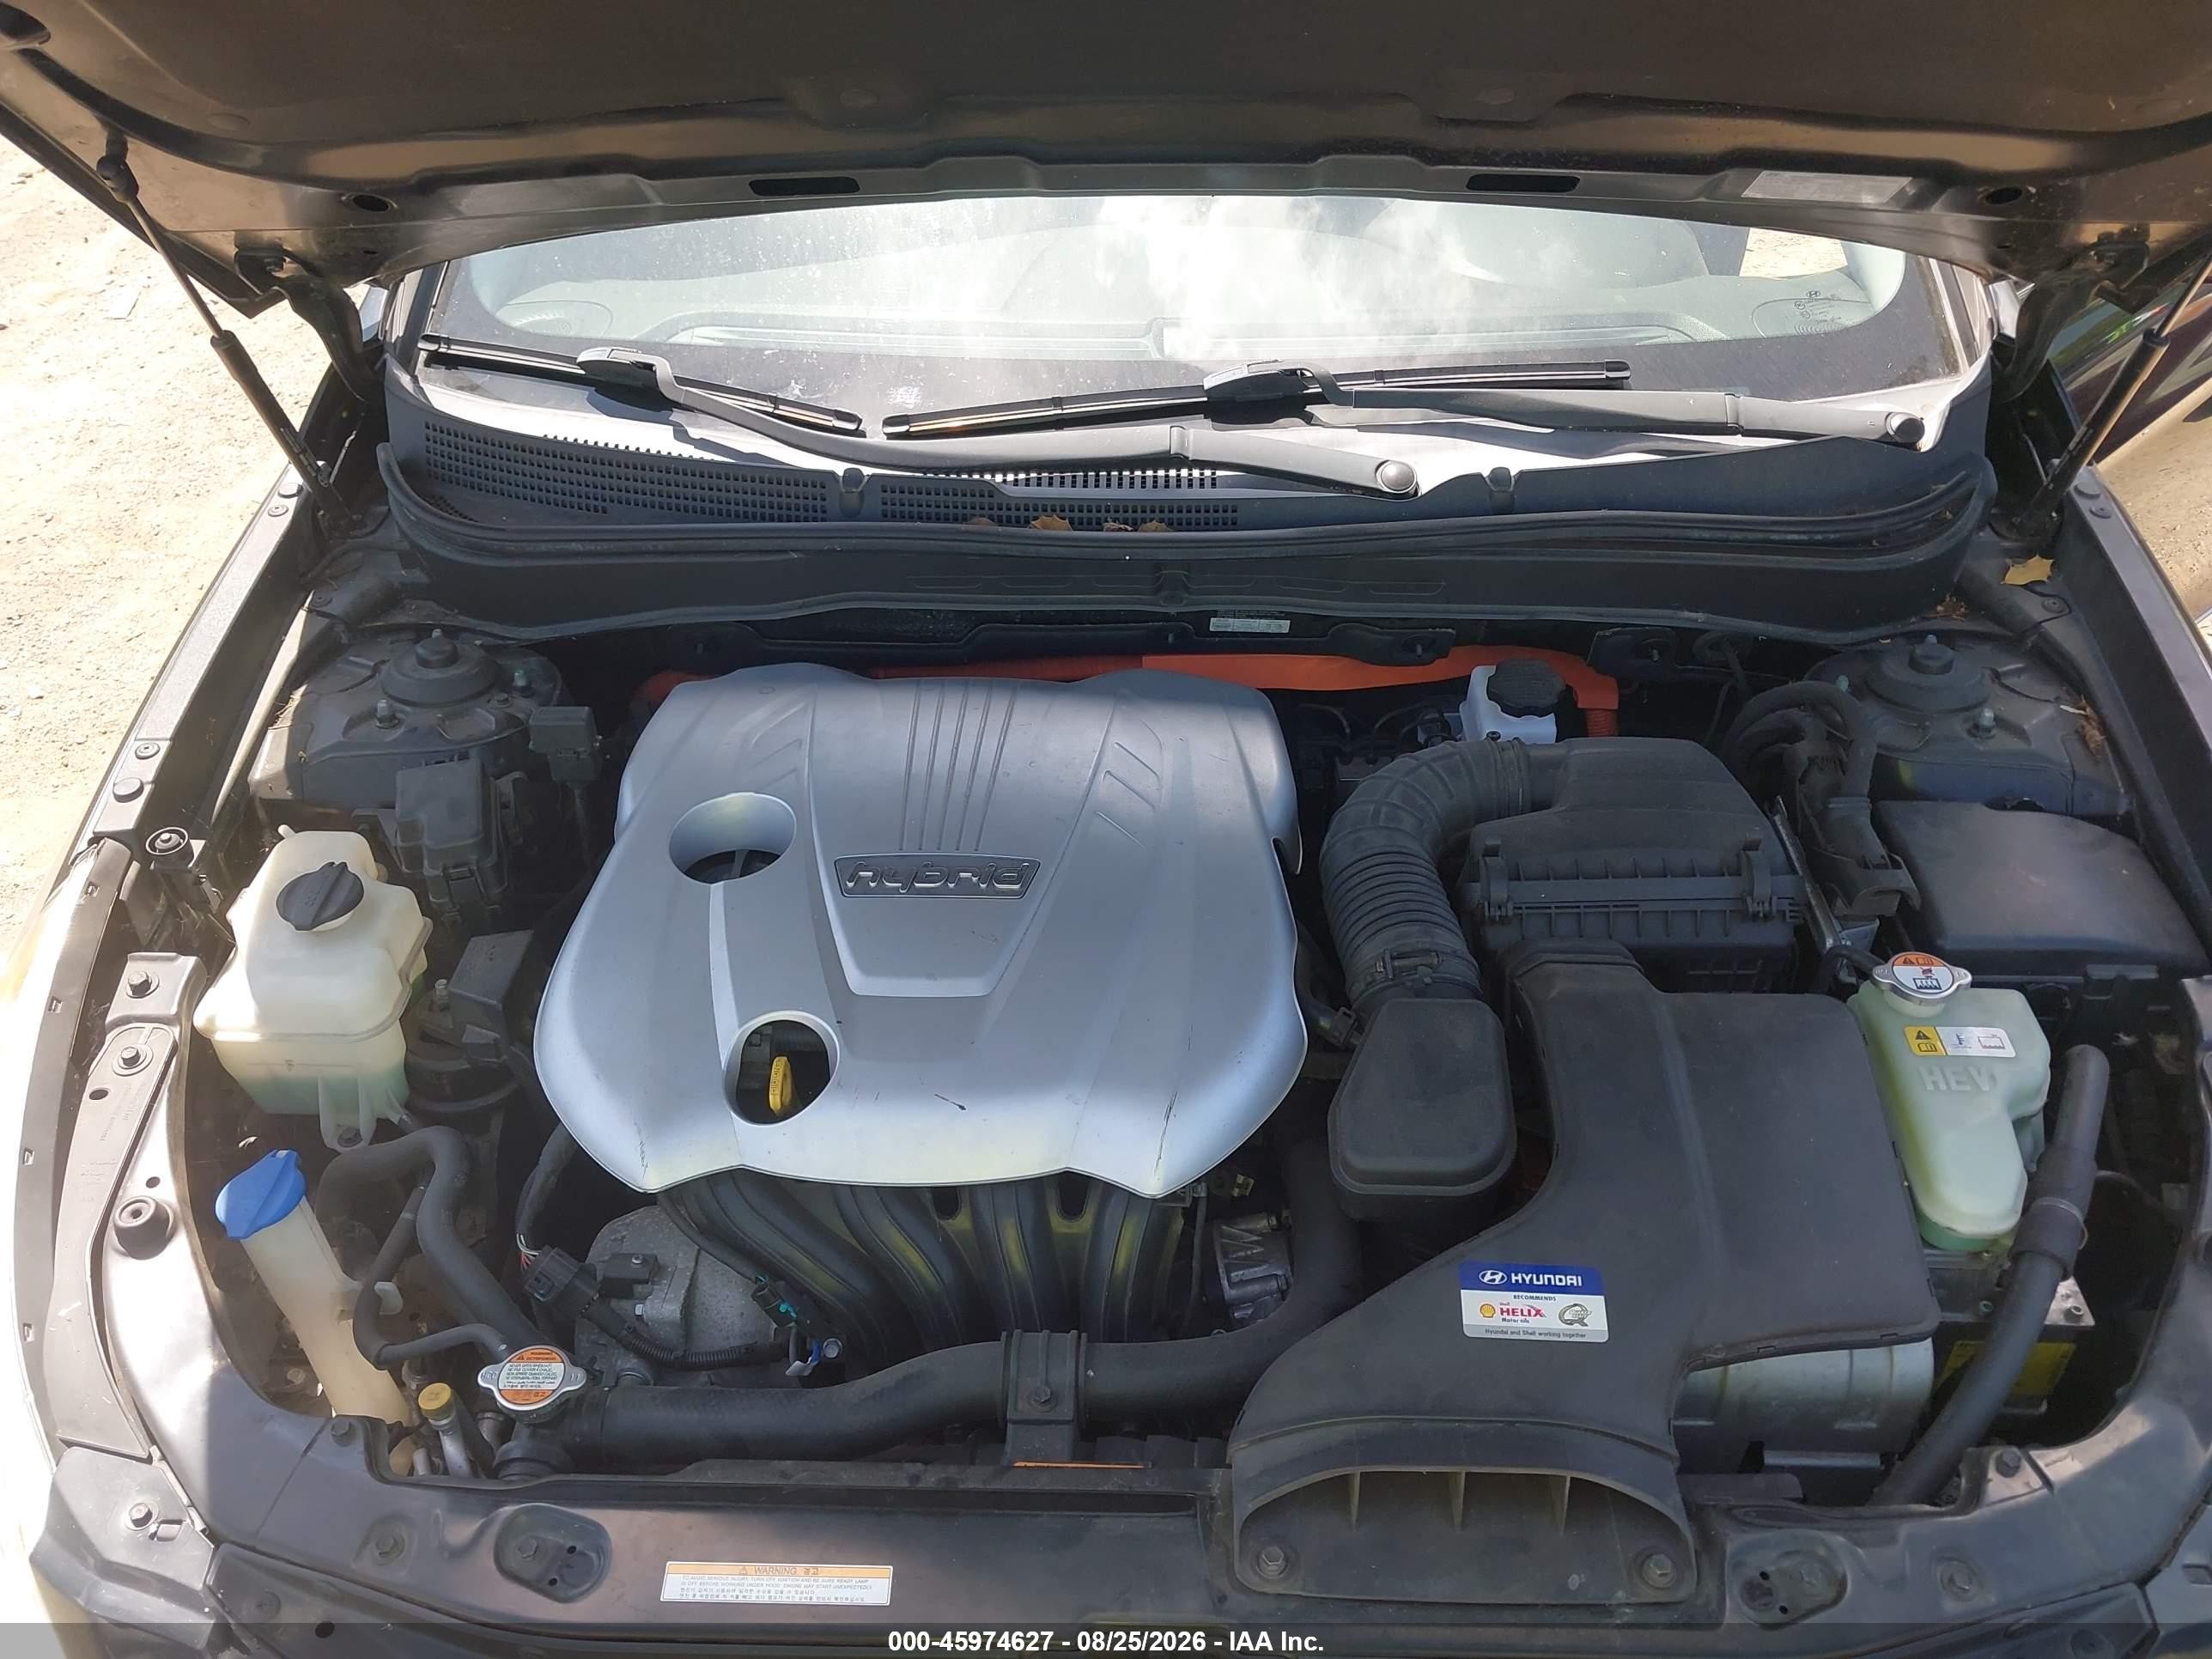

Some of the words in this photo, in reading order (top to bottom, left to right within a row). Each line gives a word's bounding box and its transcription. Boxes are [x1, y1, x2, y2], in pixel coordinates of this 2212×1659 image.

[845, 860, 1030, 893] hybrid
[1921, 1065, 1994, 1092] HEV
[1510, 1273, 1583, 1287] HYUNDAI
[1499, 1306, 1546, 1318] HELIX
[1538, 1330, 1561, 1339] working
[754, 1566, 797, 1576] WARNING
[804, 1567, 819, 1576] 경고
